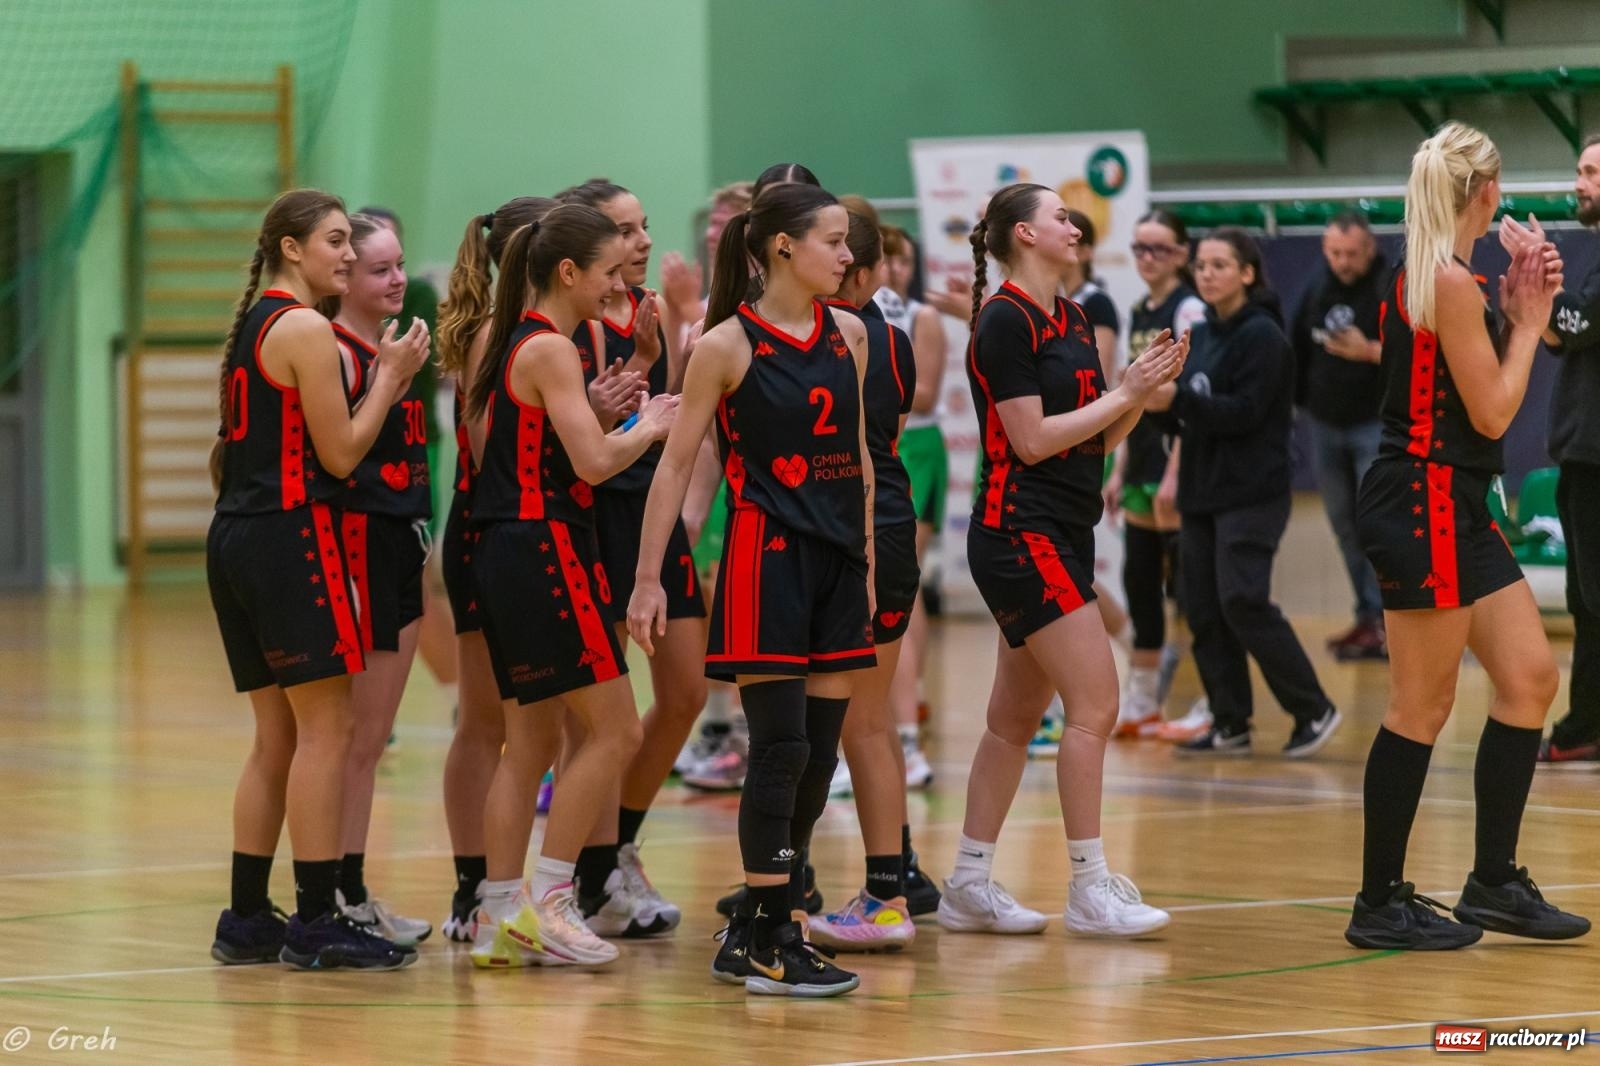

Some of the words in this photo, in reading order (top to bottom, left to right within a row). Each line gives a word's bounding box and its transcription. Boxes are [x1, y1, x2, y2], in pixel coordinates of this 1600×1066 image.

[402, 399, 427, 446] 30
[809, 386, 838, 436] 2
[812, 451, 852, 467] GMINA
[593, 561, 612, 605] 8
[679, 555, 694, 598] 7
